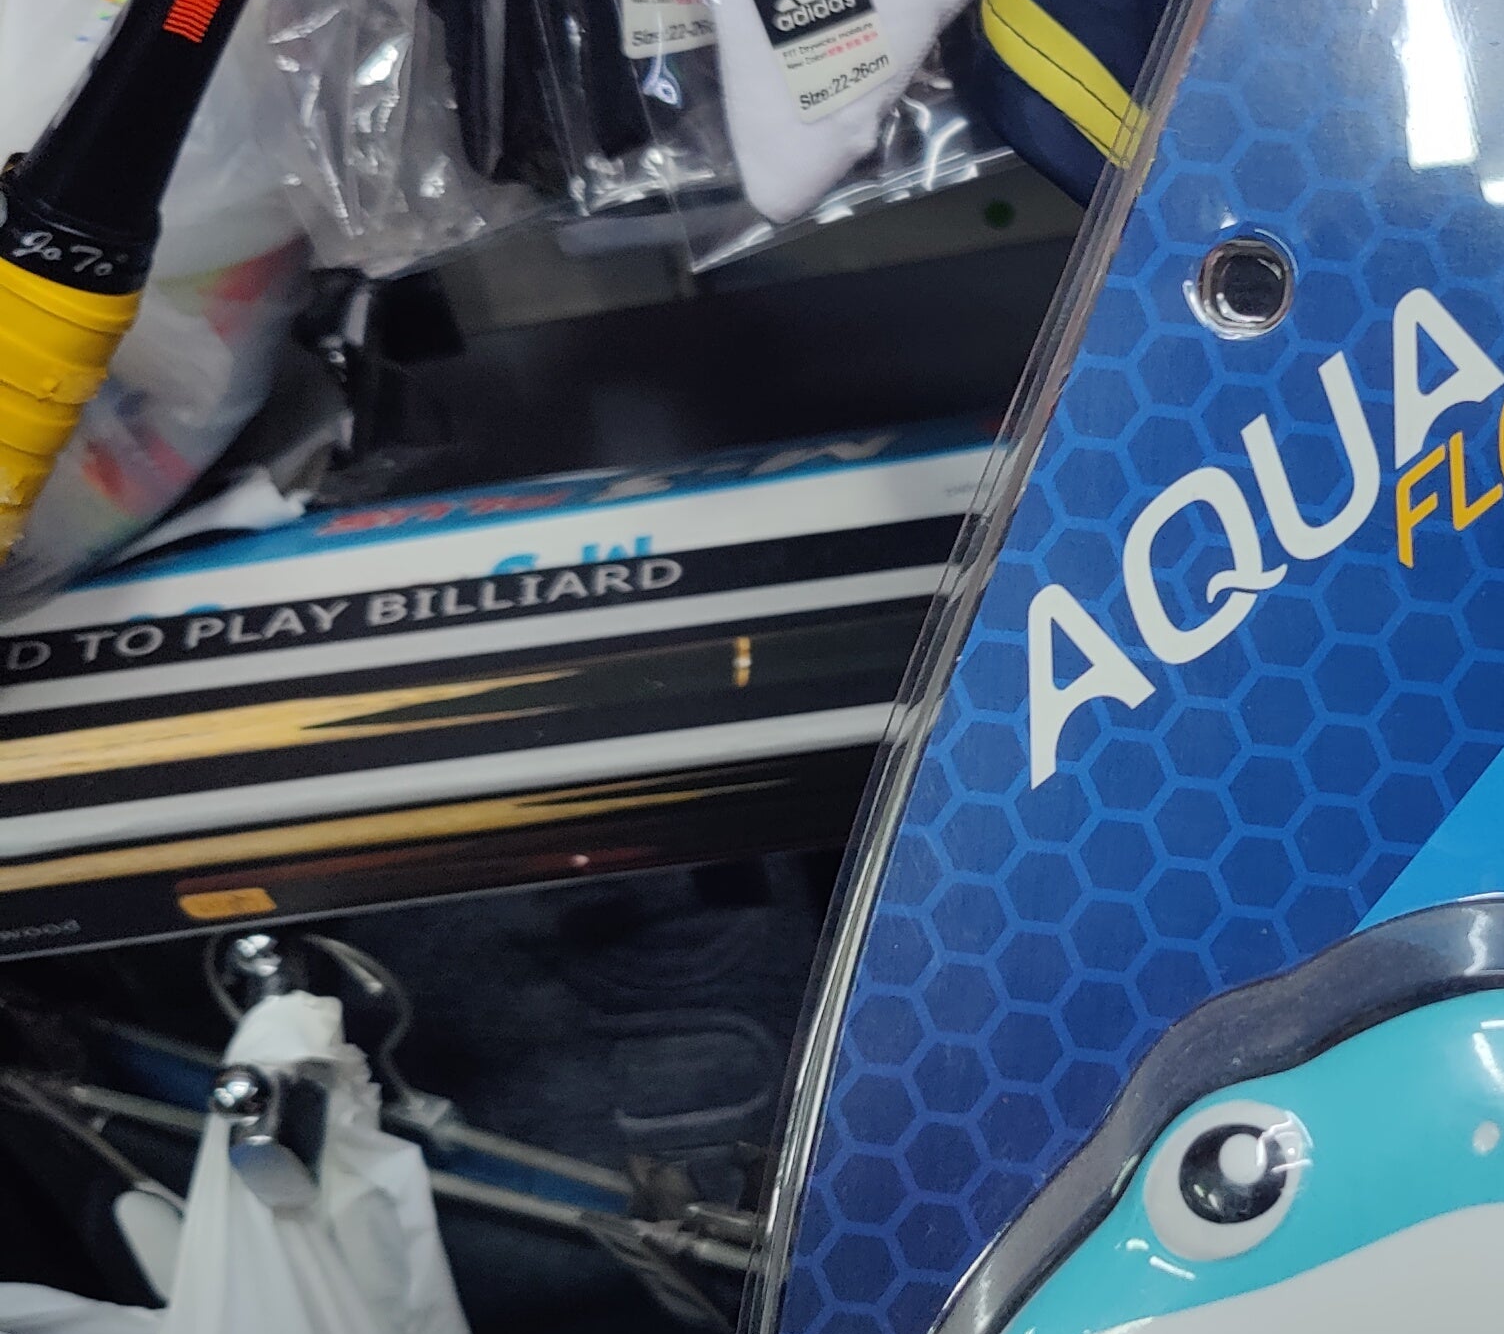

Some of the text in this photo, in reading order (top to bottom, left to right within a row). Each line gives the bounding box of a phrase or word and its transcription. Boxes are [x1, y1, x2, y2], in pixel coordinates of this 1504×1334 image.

[73, 625, 165, 665] TO
[184, 598, 351, 652] PLAY
[366, 557, 685, 629] BILLIARD
